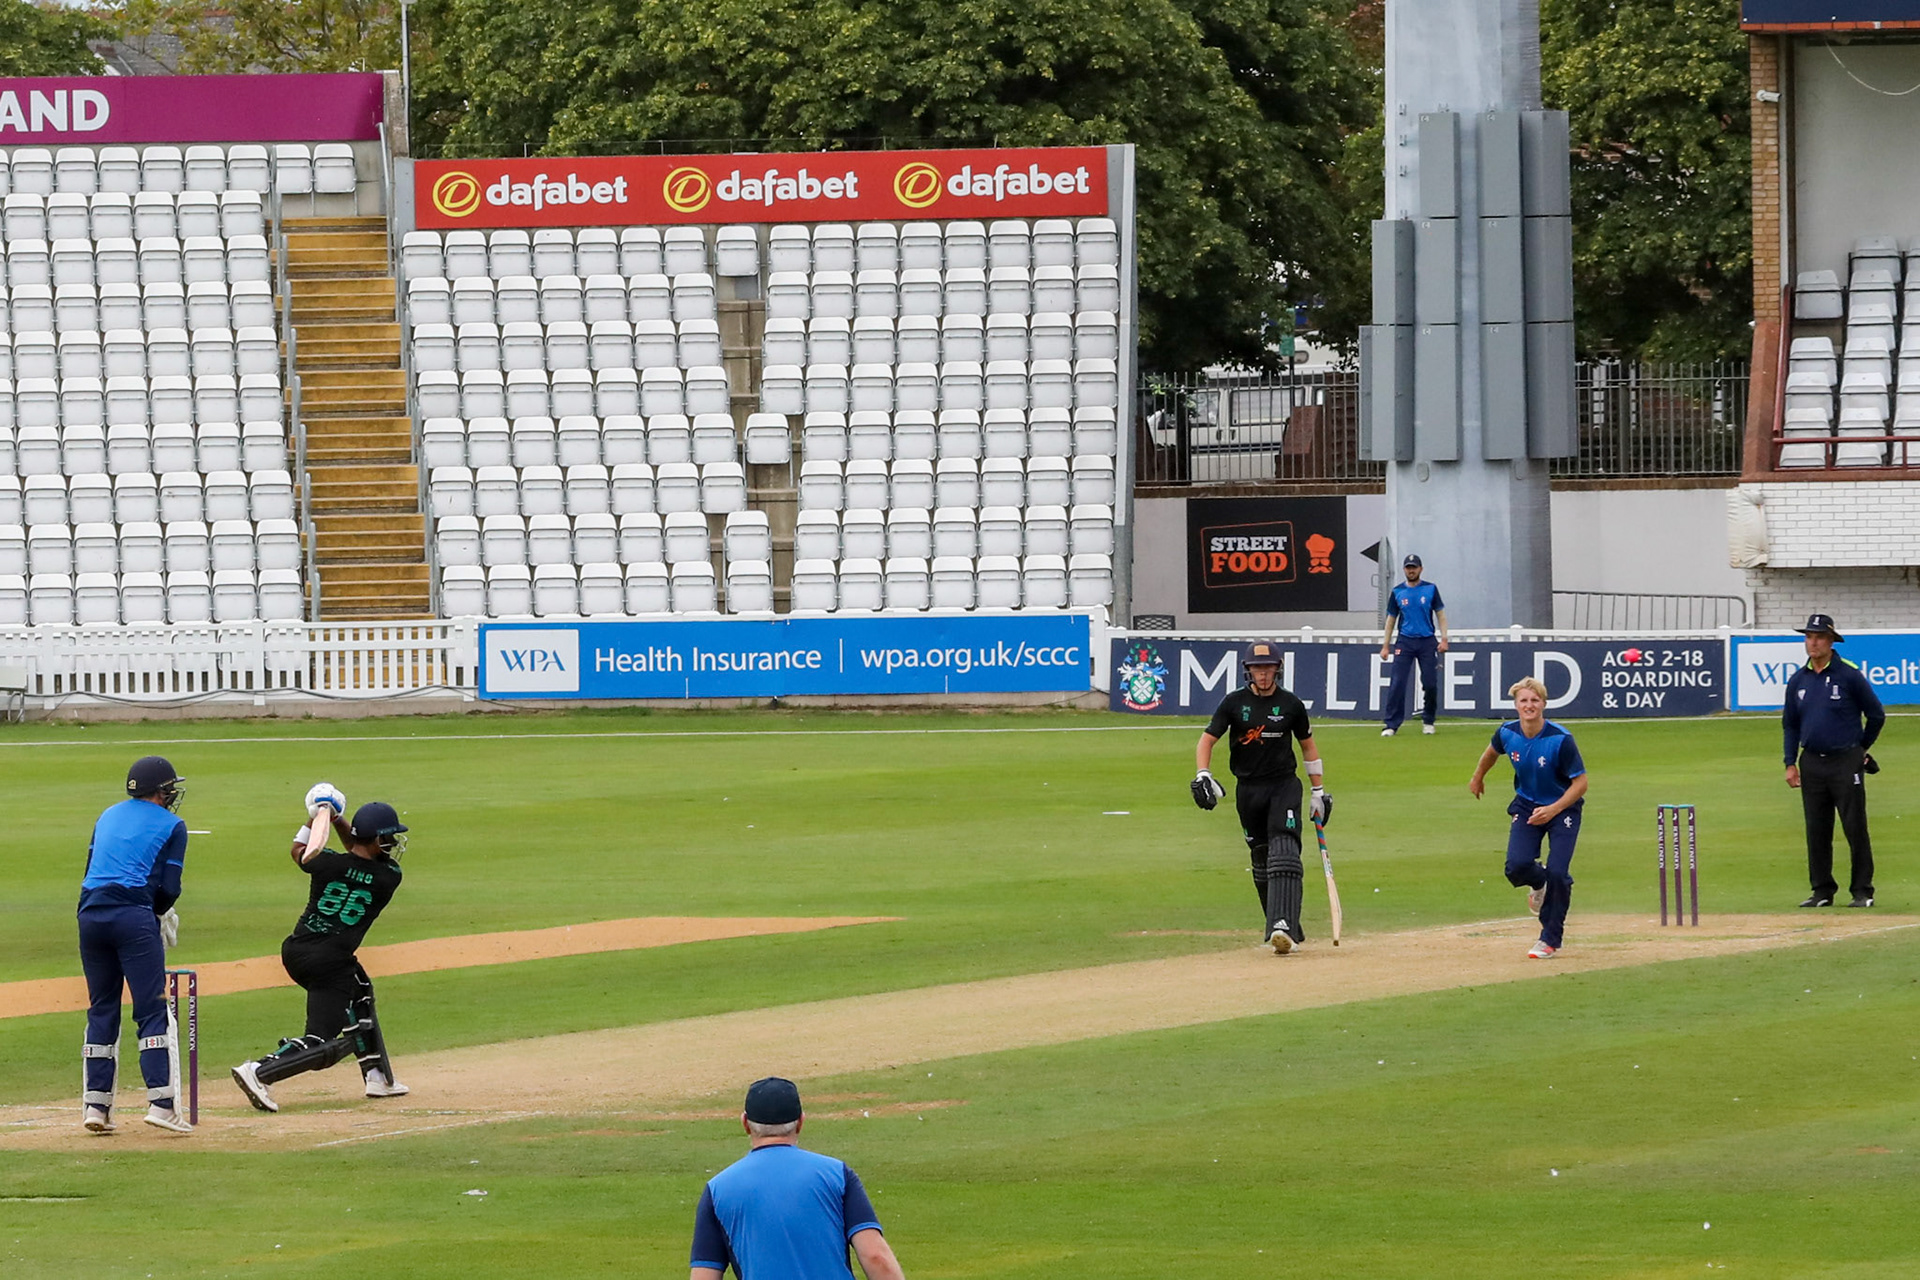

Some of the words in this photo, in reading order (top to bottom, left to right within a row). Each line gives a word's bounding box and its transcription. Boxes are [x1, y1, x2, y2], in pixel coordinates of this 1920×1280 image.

[486, 173, 628, 211] dafabet
[716, 168, 859, 207] dafabet
[947, 163, 1090, 202] dafabet
[1210, 536, 1287, 551] STREET
[1210, 552, 1288, 573] FOOD
[500, 649, 566, 672] WPA
[595, 646, 682, 672] Health
[693, 647, 822, 672] Insurance
[860, 641, 1079, 674] wpa.org.uk/sccc
[1661, 650, 1704, 667] 2-18
[1601, 671, 1712, 687] BOARDING
[1752, 662, 1801, 686] WP
[1602, 692, 1619, 708] &
[1625, 692, 1666, 708] DAY
[317, 881, 373, 926] 86
